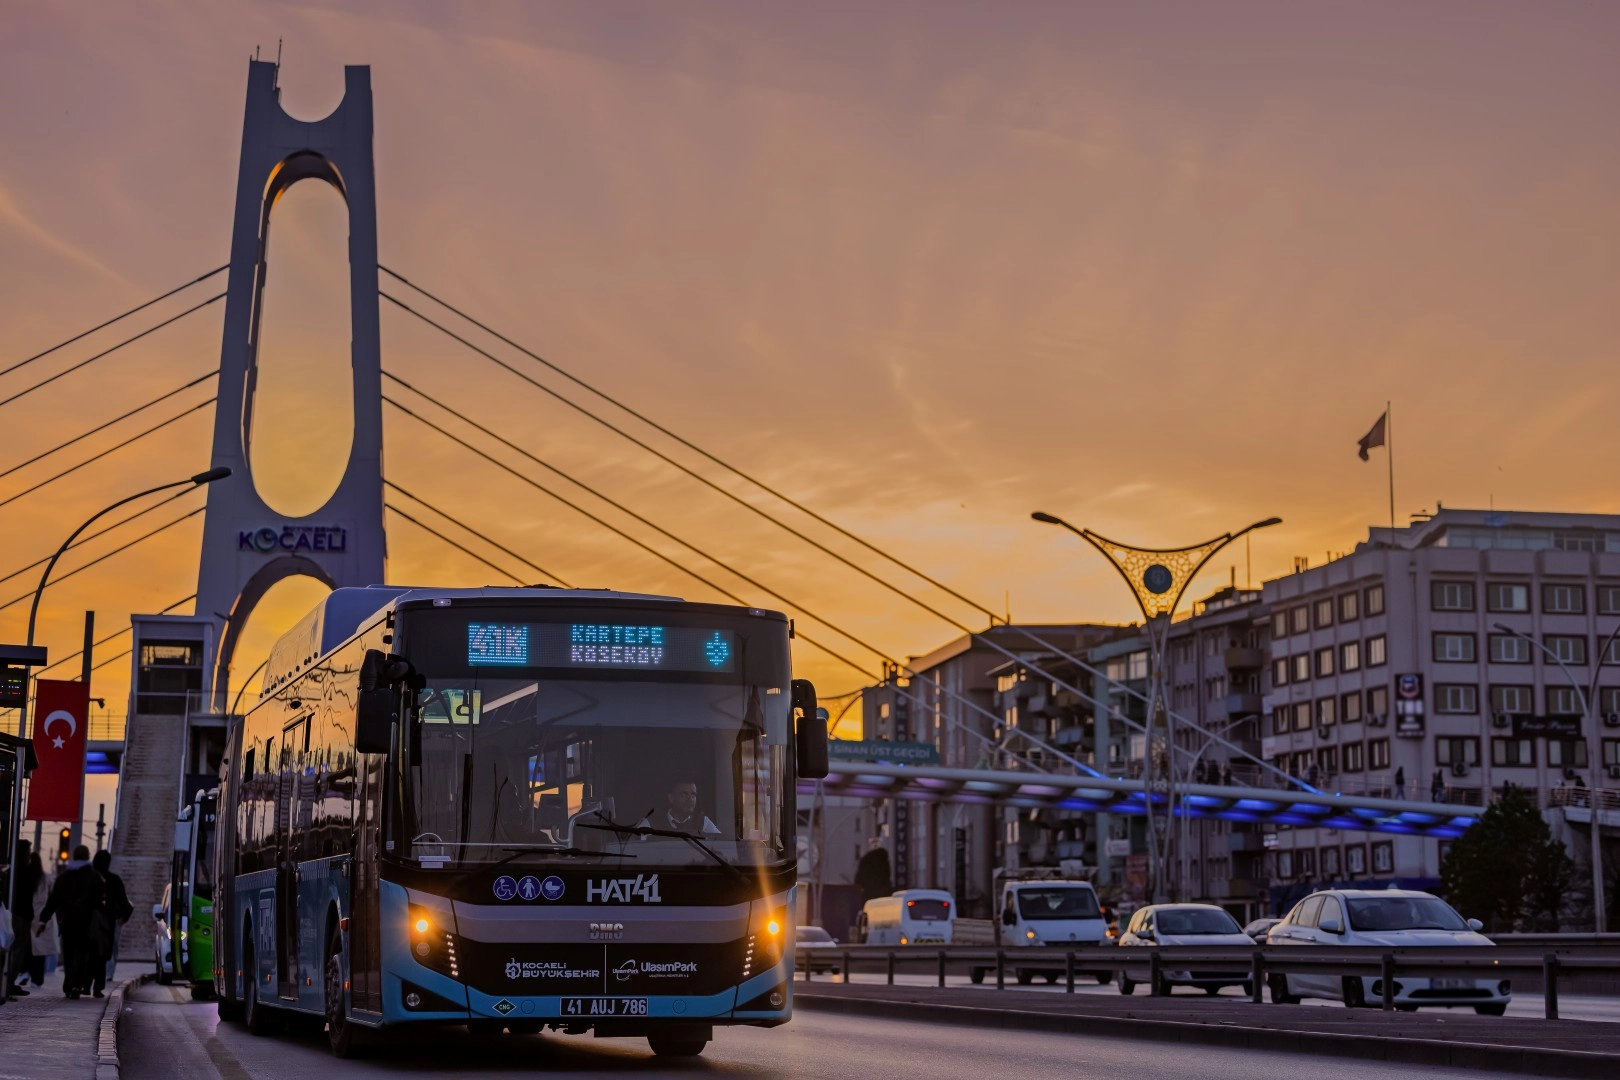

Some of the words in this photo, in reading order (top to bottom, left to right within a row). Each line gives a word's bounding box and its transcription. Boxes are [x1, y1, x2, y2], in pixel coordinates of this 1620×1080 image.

[472, 629, 522, 656] 41K
[572, 625, 663, 644] KARTEPE
[870, 744, 890, 756] ÜST
[586, 873, 661, 903] HAT41
[589, 923, 624, 940] BMC
[567, 999, 582, 1014] 41
[590, 999, 615, 1014] AUJ
[622, 999, 647, 1014] 786
